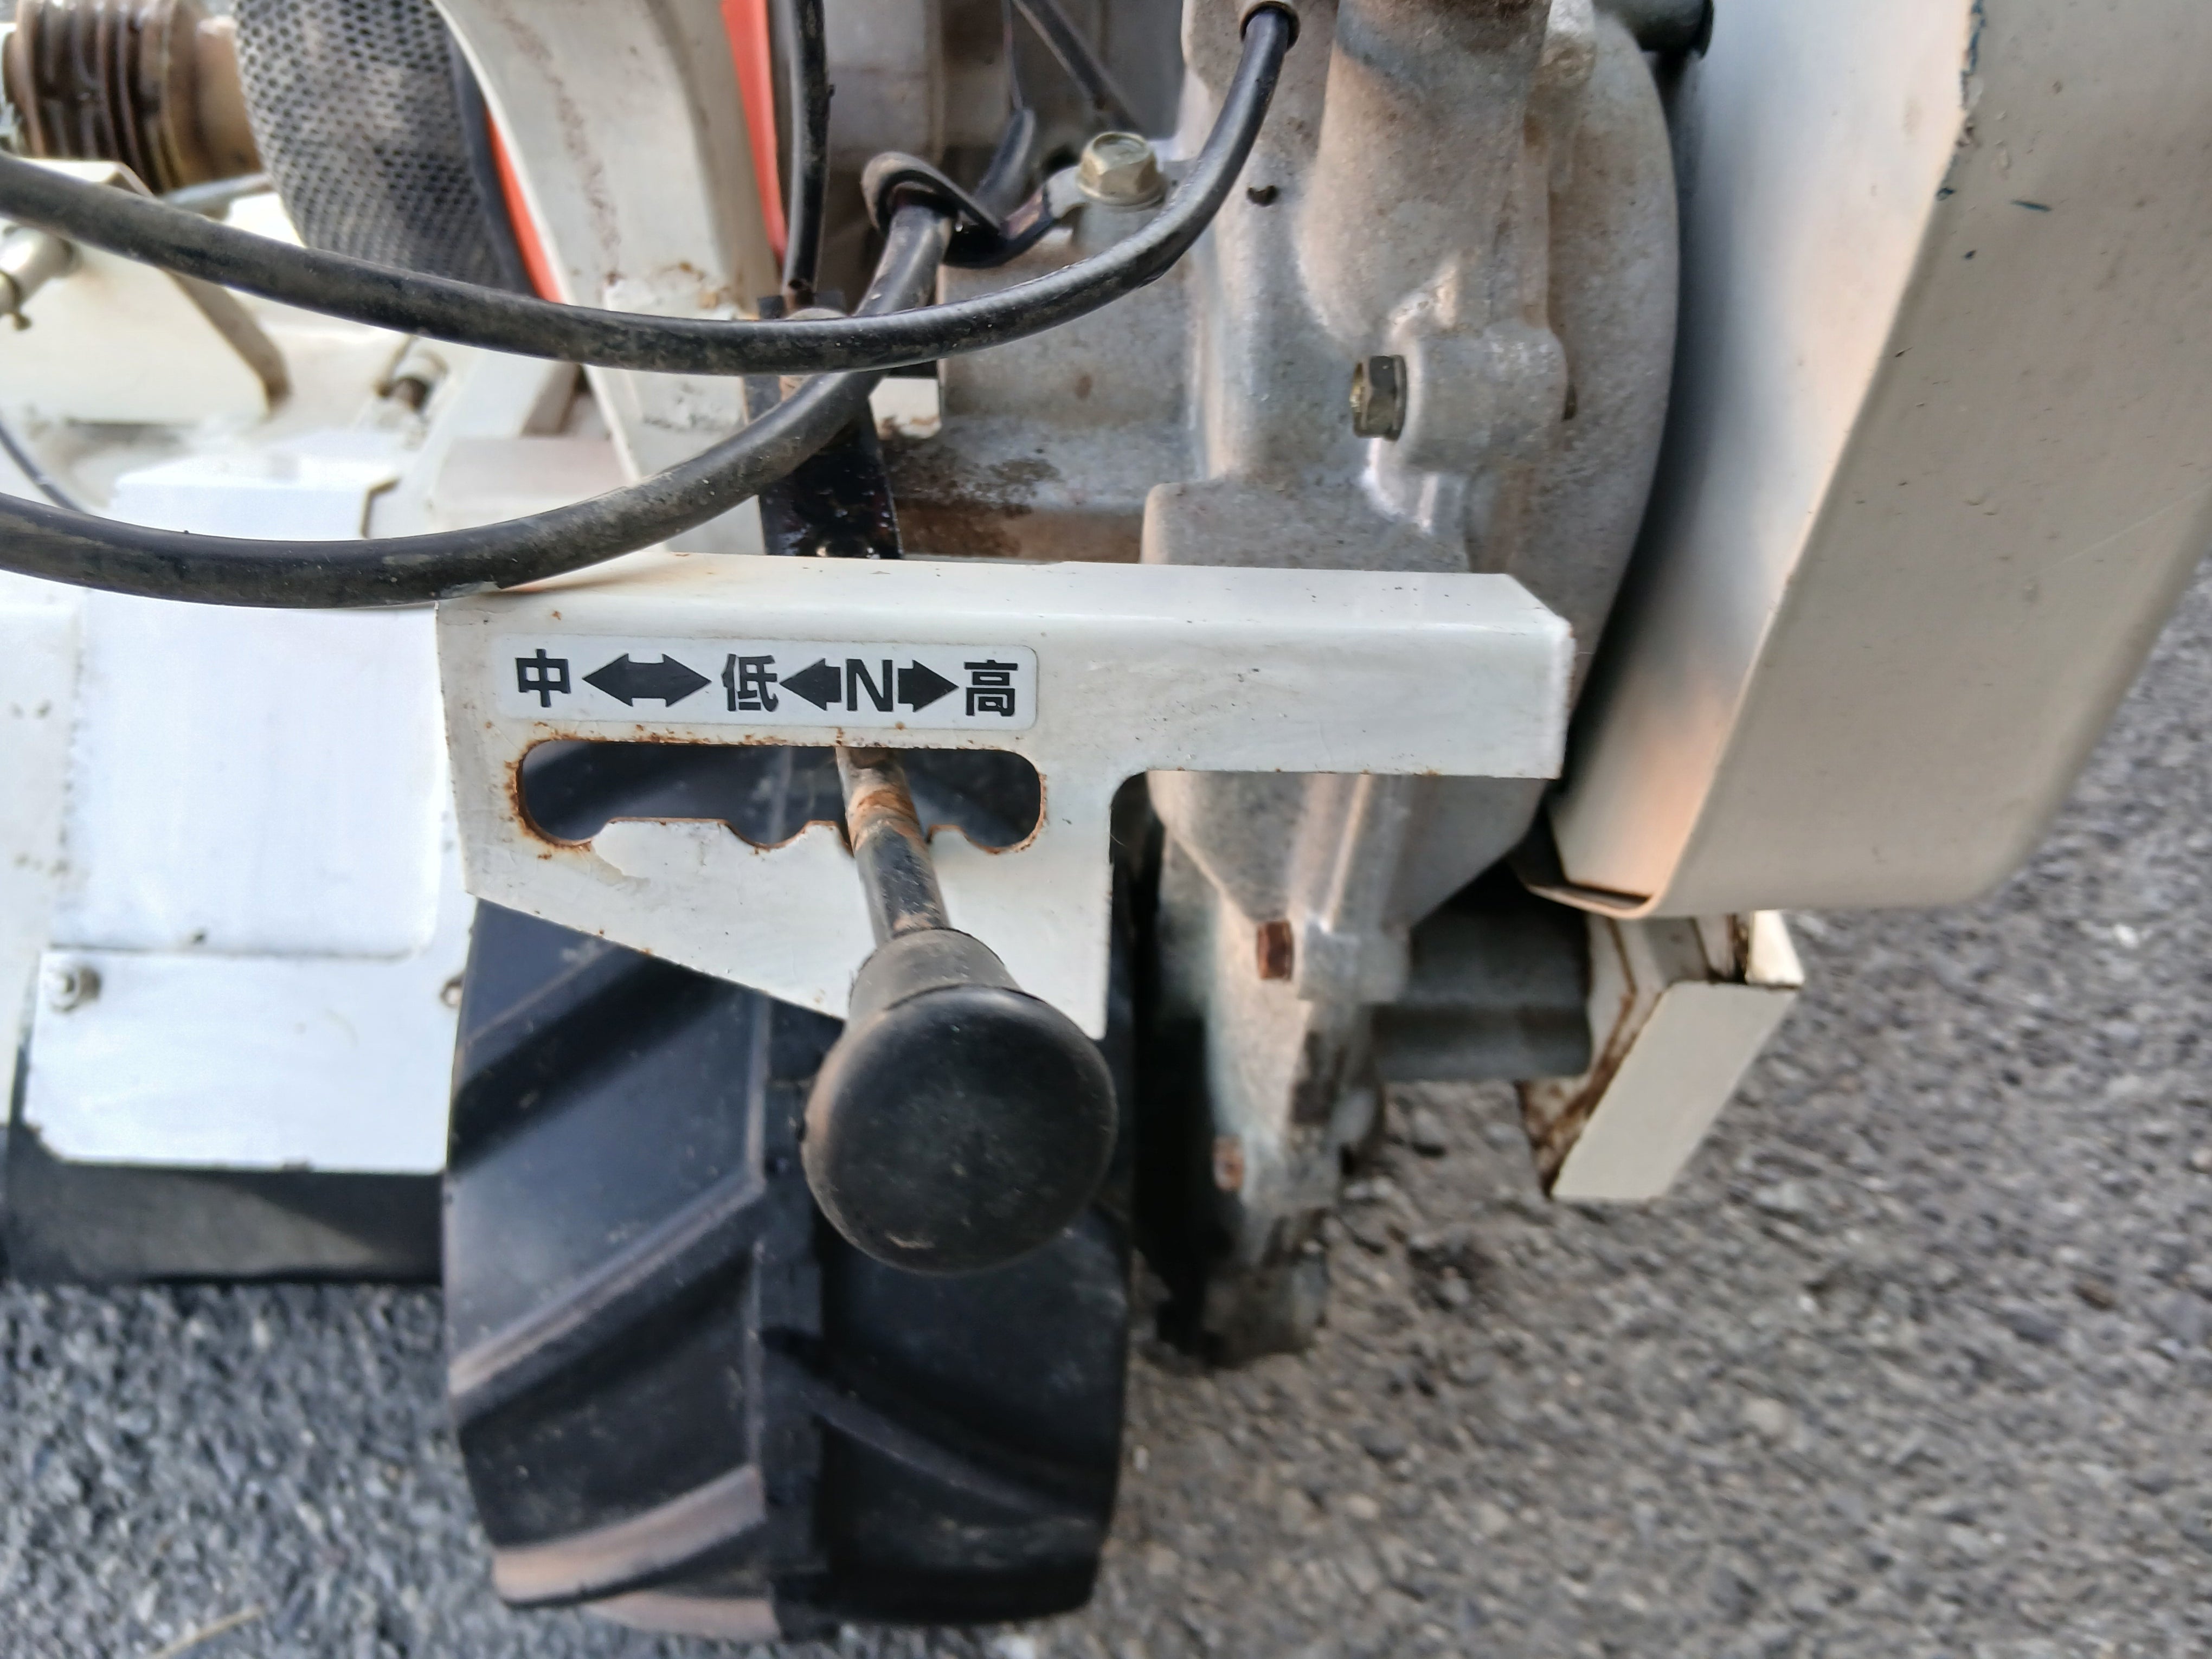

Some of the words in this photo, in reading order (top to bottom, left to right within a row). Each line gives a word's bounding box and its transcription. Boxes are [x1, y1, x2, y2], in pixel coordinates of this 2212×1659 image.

[516, 648, 571, 708] 中
[722, 654, 779, 712] 低
[846, 659, 893, 712] N
[964, 659, 1019, 717] 高
